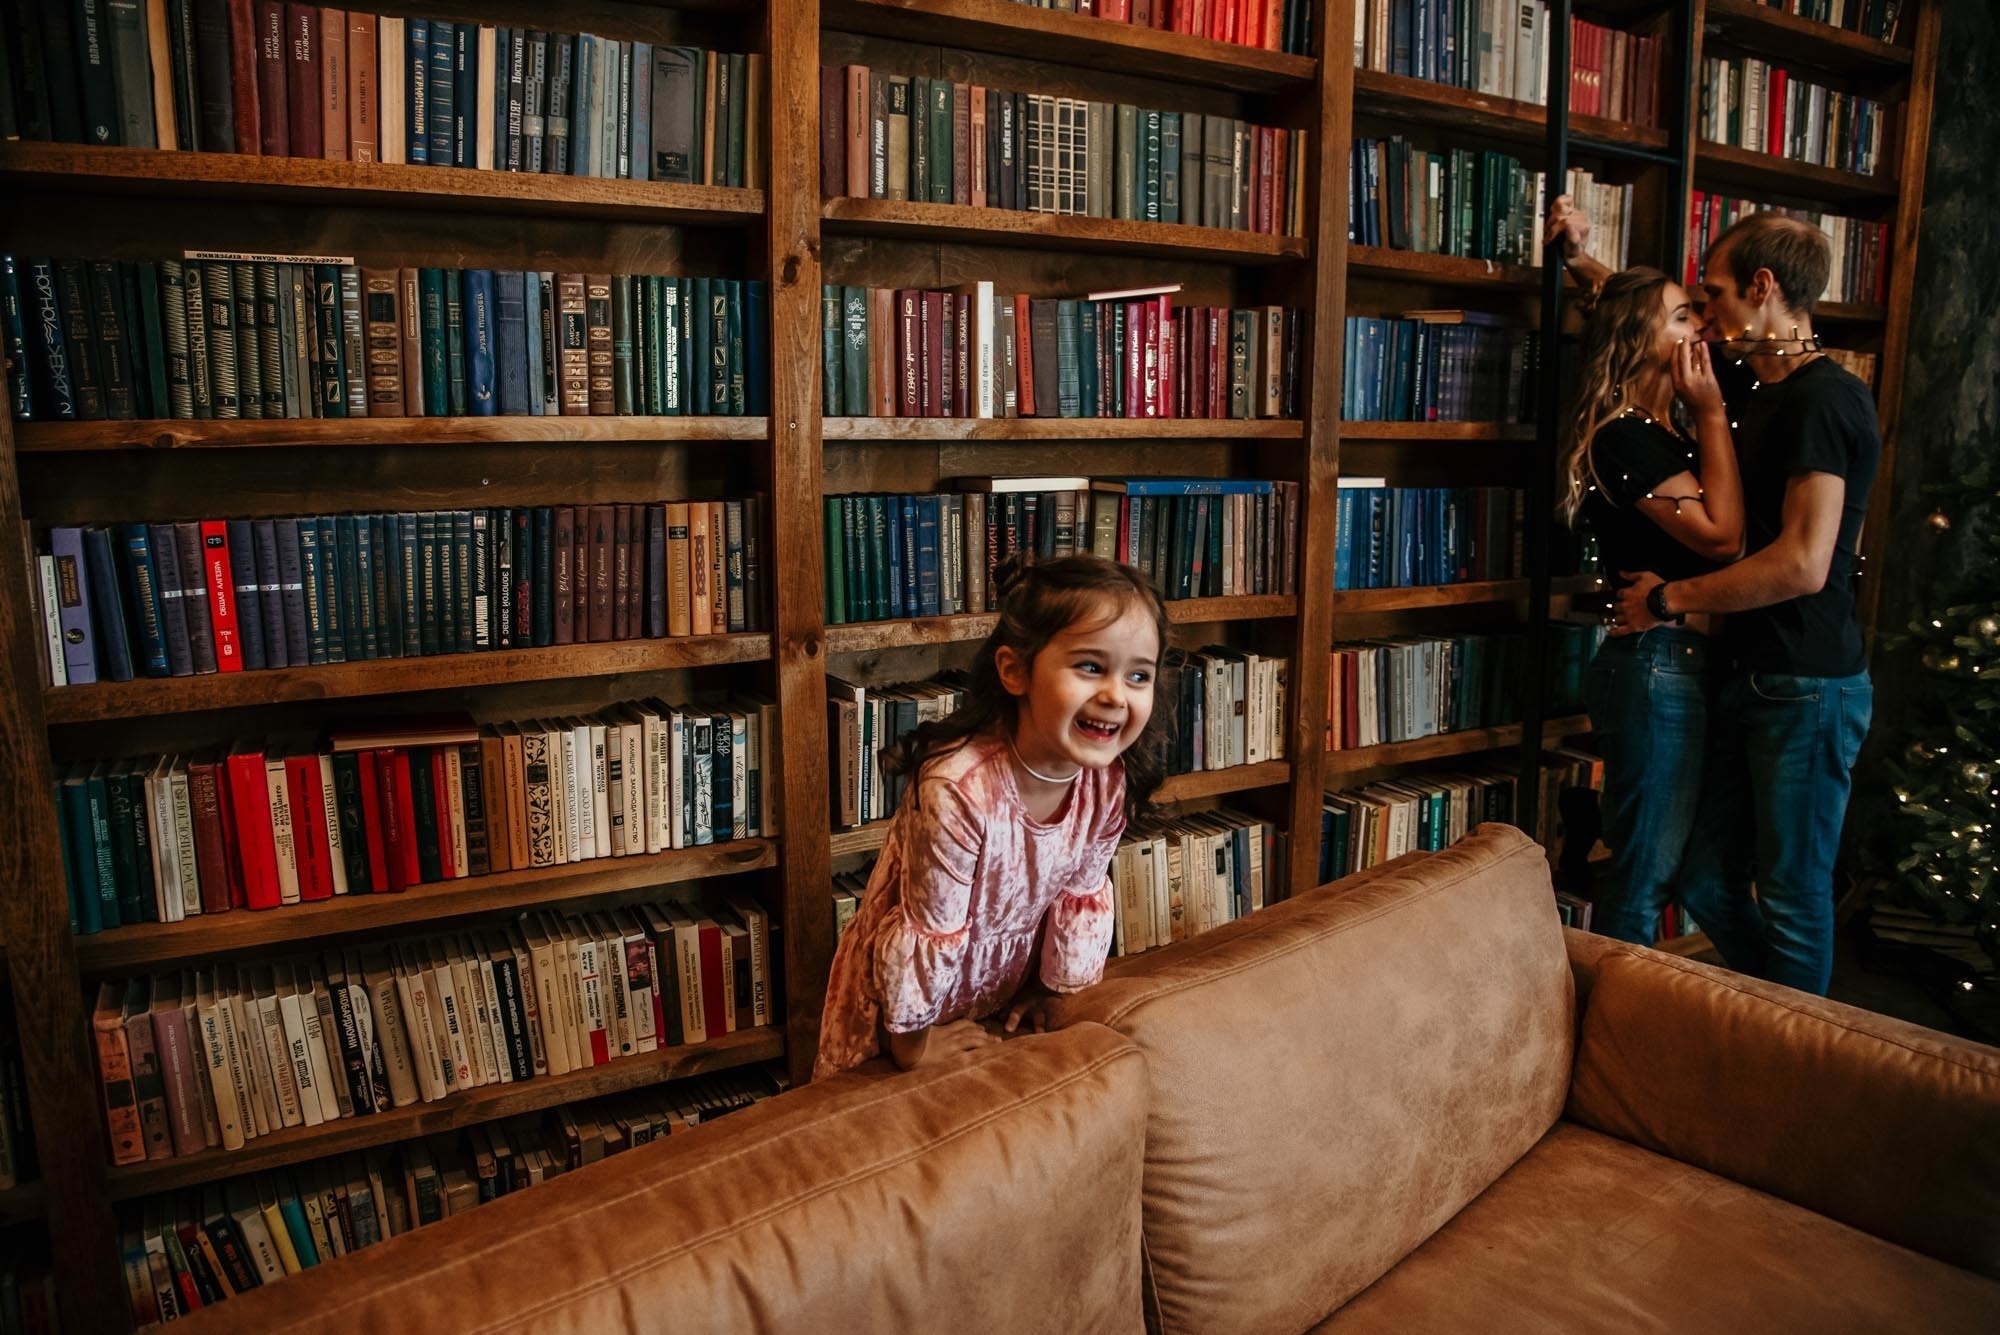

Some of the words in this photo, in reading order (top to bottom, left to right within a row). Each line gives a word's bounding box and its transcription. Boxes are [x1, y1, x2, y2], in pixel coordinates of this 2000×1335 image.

[264, 38, 272, 58] ЮРІЙ
[271, 13, 280, 59] ЯНОВСЬКИЙ
[294, 40, 303, 60] ЮРІЙ
[301, 16, 310, 62] ЯНОВСЬКИЙ
[509, 100, 520, 136] ШКЛЯР
[33, 264, 58, 330] ЛОНДОН
[48, 344, 70, 397] ДЖЕК
[959, 352, 967, 390] ВИКТОРИЯ
[60, 402, 72, 414] 2
[475, 532, 484, 546] СОН
[214, 560, 224, 589] АЛГЕБРА
[476, 547, 486, 592] УКРАДЕННЫЙ
[218, 591, 227, 616] ОБЩАЯ
[276, 785, 285, 826] МЛАДШЕГО
[582, 787, 590, 809] СССР
[630, 778, 638, 843] ЗАКОНОДАТЕЛЬСТВО
[582, 817, 592, 835] СУД
[754, 981, 764, 1001] РУСИ
[380, 990, 396, 1025] ОБРЫВ
[756, 1003, 765, 1015] ПО
[293, 1039, 305, 1057] ТОНЪ
[295, 1060, 312, 1089] ХОРОШИЙ
